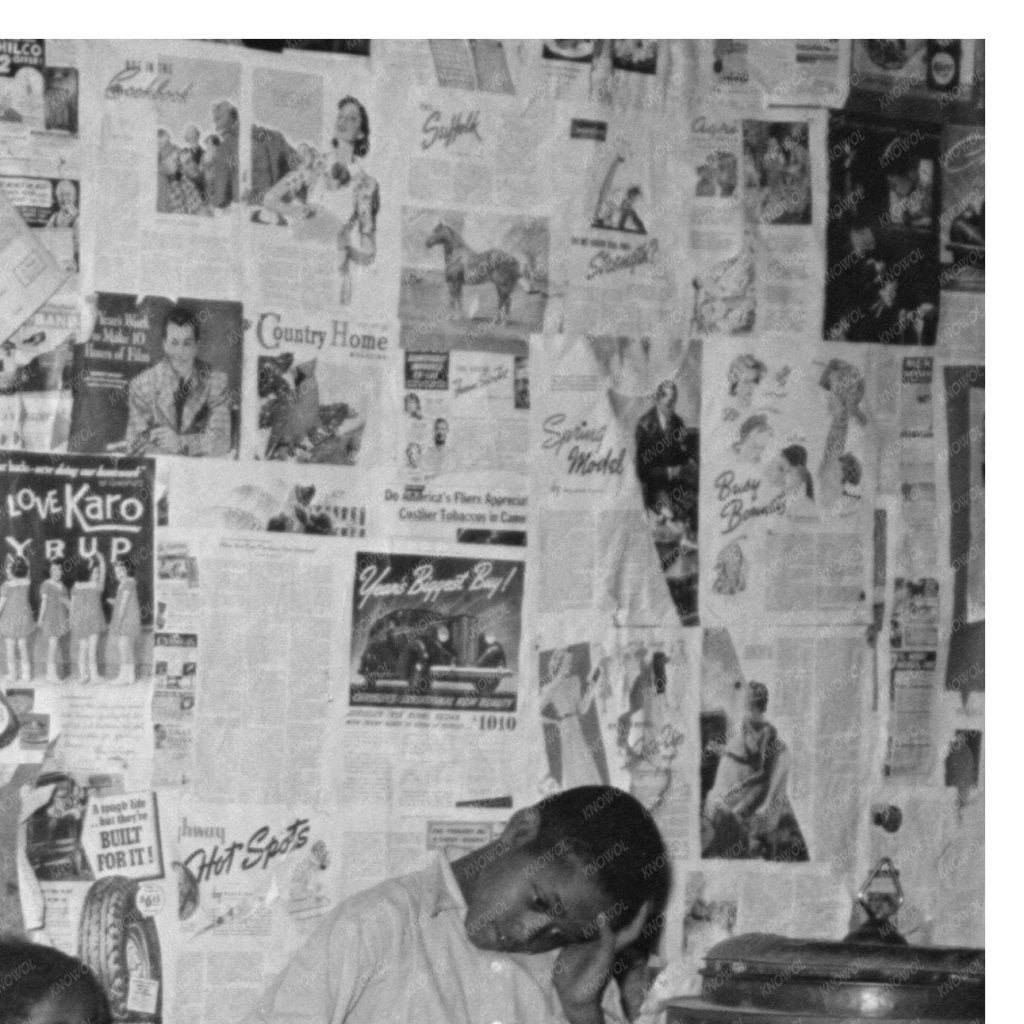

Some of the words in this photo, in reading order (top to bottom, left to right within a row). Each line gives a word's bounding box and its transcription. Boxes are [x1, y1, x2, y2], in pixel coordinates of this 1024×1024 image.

[257, 312, 327, 350] Country
[331, 320, 388, 351] Home
[542, 412, 608, 457] Spring
[567, 446, 626, 476] Model
[384, 489, 399, 502] Do
[7, 488, 63, 520] LOVE
[65, 484, 144, 532] Karo
[399, 507, 437, 521] Costlier
[490, 511, 499, 523] in
[101, 801, 128, 814] tough
[130, 797, 146, 810] life
[117, 811, 148, 825] they're
[99, 826, 143, 849] BUILT
[97, 850, 127, 872] FOR
[184, 842, 244, 884] Hot
[241, 818, 311, 870] Spots
